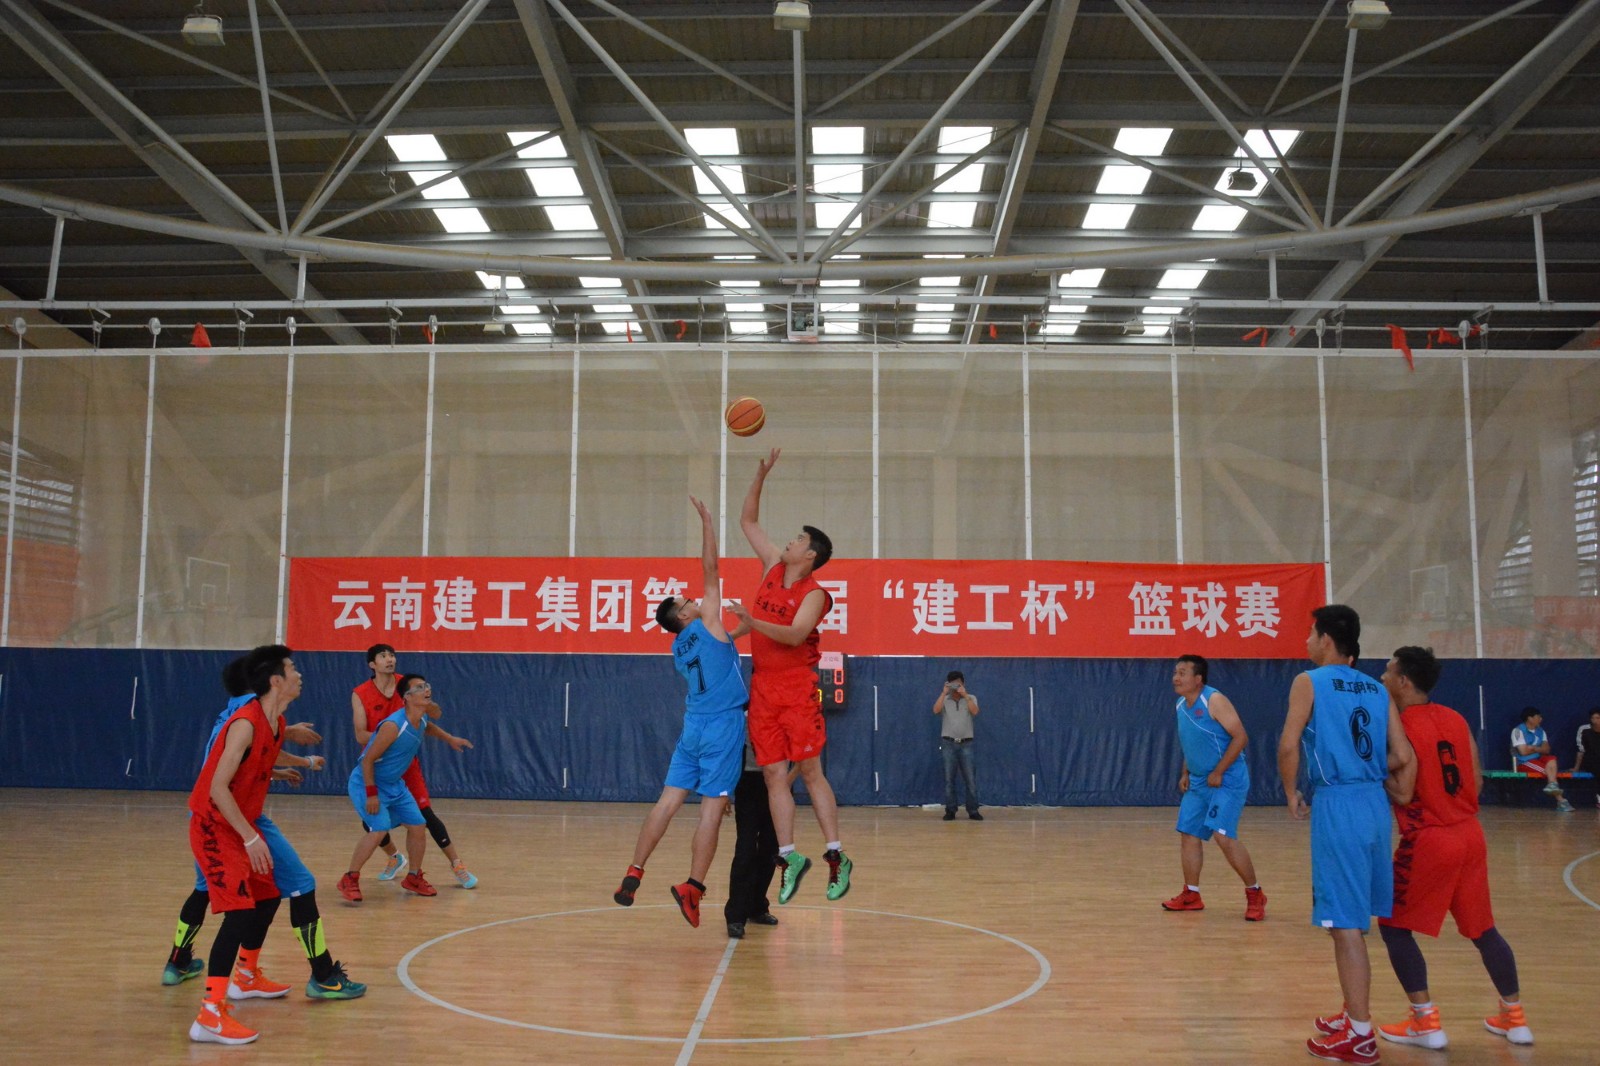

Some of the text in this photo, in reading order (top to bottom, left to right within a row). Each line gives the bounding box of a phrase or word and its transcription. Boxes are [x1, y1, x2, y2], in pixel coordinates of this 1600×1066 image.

[687, 655, 706, 694] 7
[1349, 706, 1373, 762] 6
[1437, 740, 1463, 798] 6
[237, 880, 250, 899] 4
